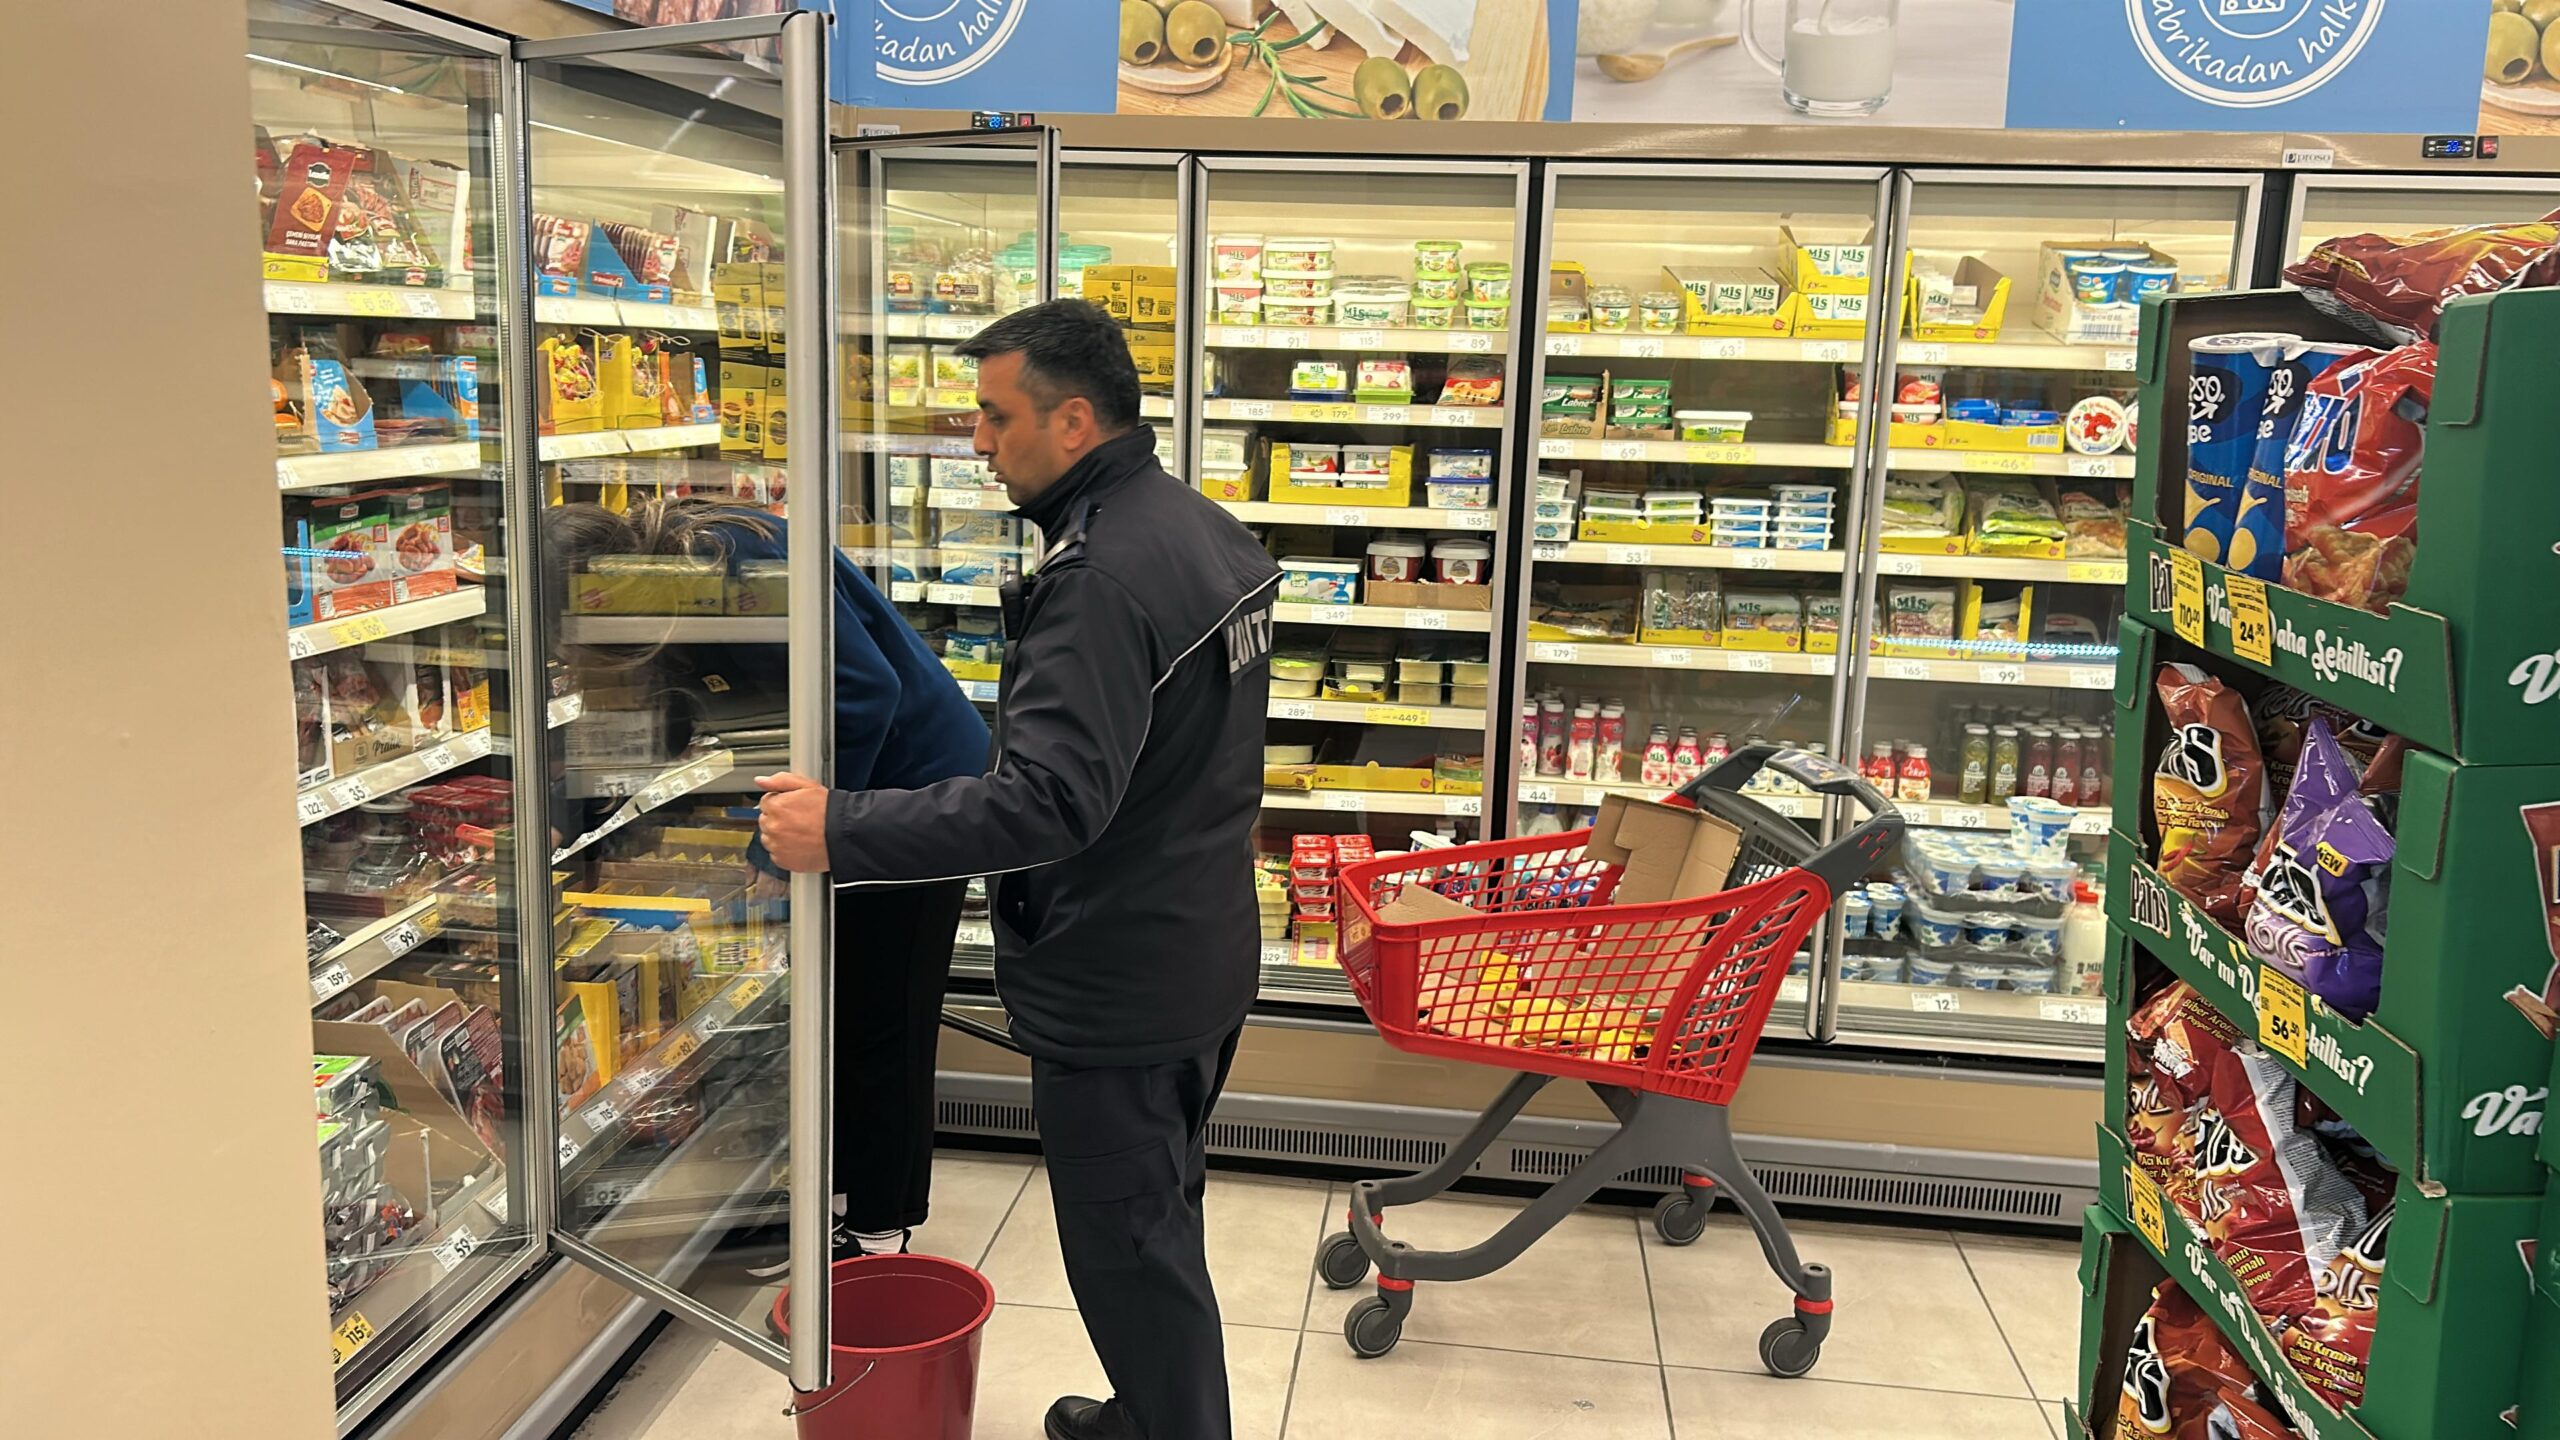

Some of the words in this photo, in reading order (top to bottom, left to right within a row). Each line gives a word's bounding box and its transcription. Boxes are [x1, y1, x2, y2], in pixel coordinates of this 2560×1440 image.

[1241, 334, 1256, 343] 115
[1287, 337, 1300, 347] 91
[1359, 336, 1374, 345] 115
[1471, 338, 1486, 348] 89
[1553, 344, 1571, 355] 94
[1638, 346, 1655, 357] 92
[1719, 345, 1736, 357] 63
[1821, 349, 1838, 360] 48
[1925, 352, 1937, 361] 21
[1248, 408, 1264, 417] 185
[1332, 409, 1348, 418] 179
[1383, 412, 1401, 421] 299
[1449, 414, 1465, 425] 94
[1546, 445, 1564, 454] 140
[1620, 447, 1637, 459] 69
[1726, 450, 1741, 460] 89
[2000, 459, 2018, 470] 46
[2089, 464, 2105, 475] 69
[955, 496, 973, 505] 289
[1343, 514, 1359, 524] 99
[1466, 517, 1482, 526] 155
[1540, 548, 1557, 559] 83
[1626, 552, 1642, 563] 53
[1751, 557, 1768, 568] 59
[1896, 562, 1913, 573] 59
[949, 592, 964, 601] 319
[1326, 610, 1345, 620] 349
[1422, 617, 1439, 626] 195
[2240, 621, 2254, 644] 24
[290, 640, 308, 657] 29
[1553, 648, 1569, 658] 179
[1670, 653, 1684, 662] 115
[1748, 658, 1764, 668] 115
[1903, 666, 1920, 675] 165
[1998, 671, 2016, 682] 99
[2089, 676, 2106, 685] 165
[1287, 708, 1306, 717] 289
[1398, 713, 1418, 723] 449
[352, 788, 367, 801] 35
[1529, 790, 1548, 801] 44
[303, 801, 322, 816] 122
[1340, 799, 1357, 808] 210
[1462, 803, 1478, 813] 45
[1778, 804, 1794, 815] 28
[1905, 812, 1921, 822] 32
[1962, 816, 1977, 826] 59
[2084, 822, 2101, 832] 29
[400, 929, 415, 948] 99
[958, 932, 974, 942] 54
[1262, 952, 1280, 962] 329
[326, 972, 345, 986] 159
[1936, 999, 1950, 1010] 12
[2062, 1010, 2078, 1020] 55
[2271, 1014, 2289, 1040] 56
[453, 1237, 470, 1257] 59
[345, 1324, 366, 1346] 115
[2313, 1343, 2359, 1367] Kırmızı
[2313, 1357, 2364, 1385] Aromalı
